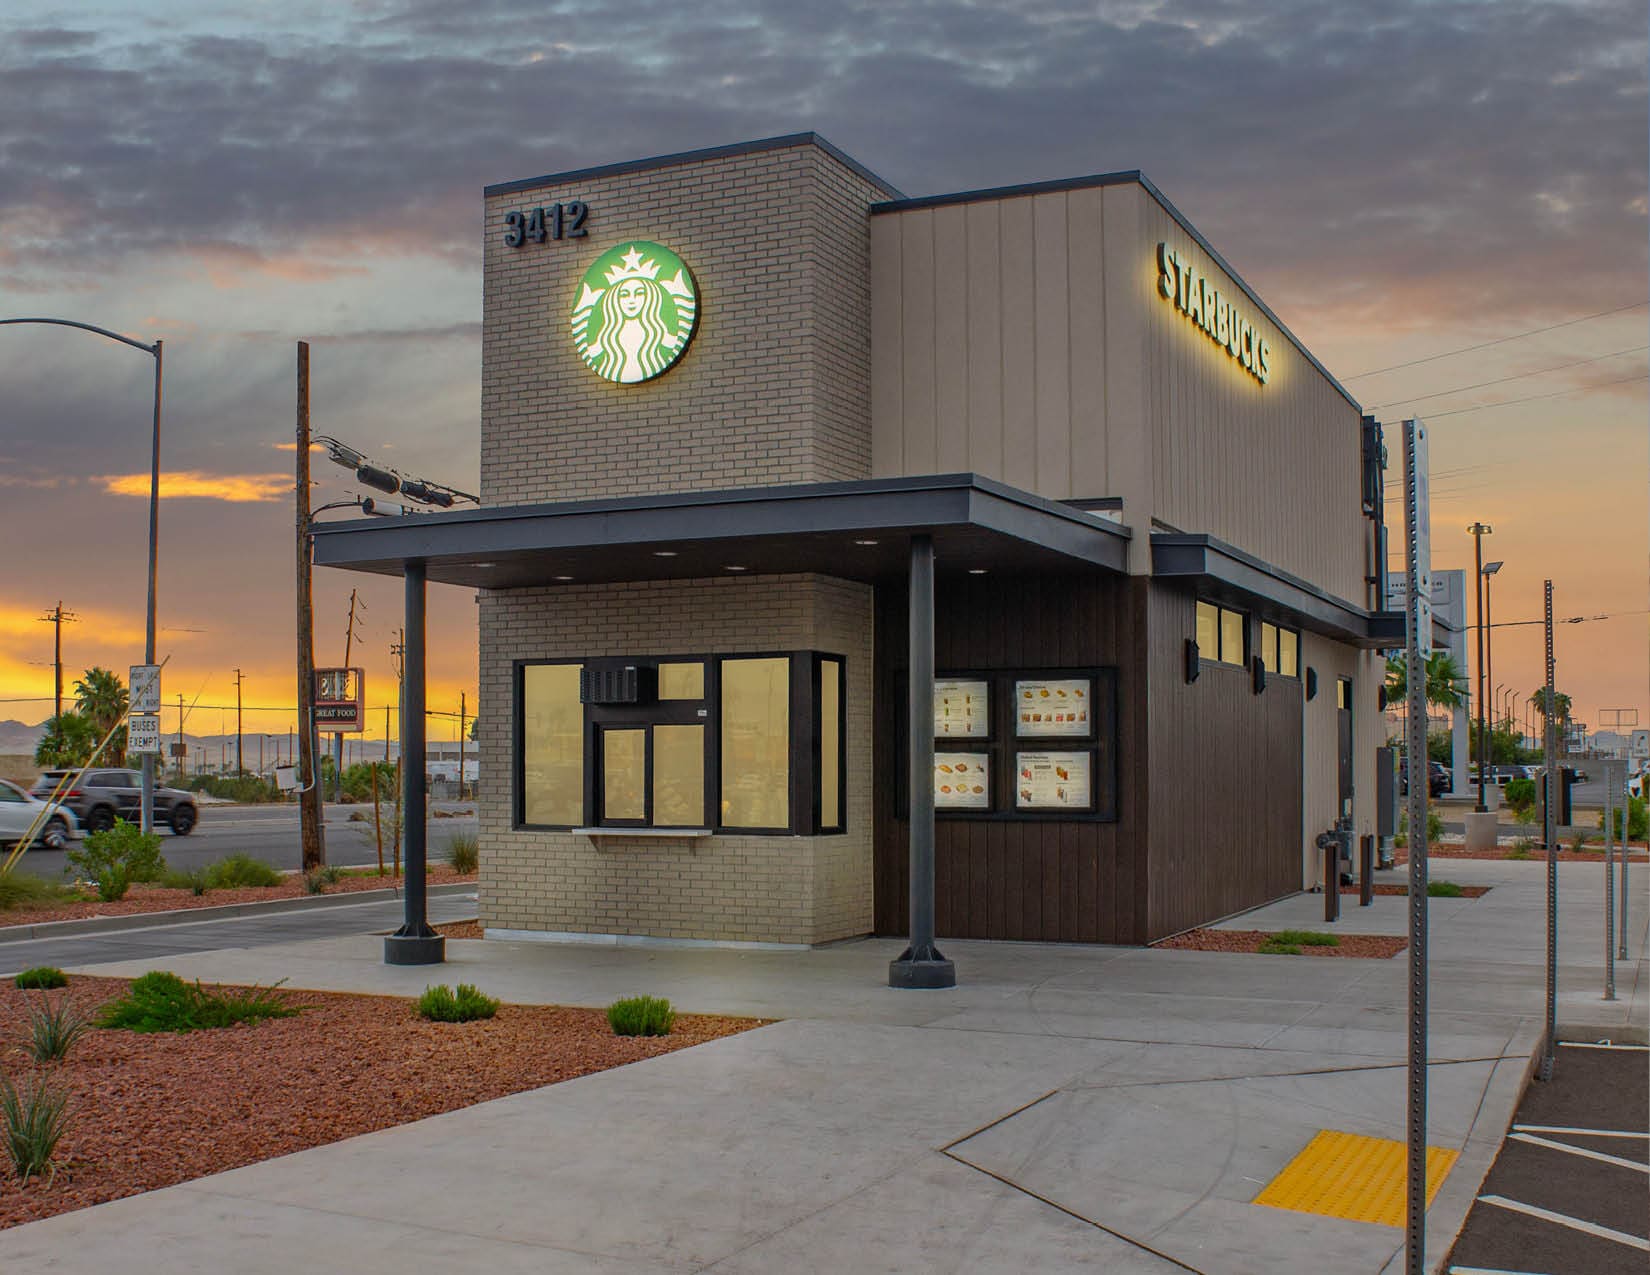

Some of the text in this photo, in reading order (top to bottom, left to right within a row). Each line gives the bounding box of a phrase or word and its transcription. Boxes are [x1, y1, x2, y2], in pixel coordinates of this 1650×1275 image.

[505, 199, 589, 248] 3412
[1157, 241, 1272, 385] STARBUCKS
[338, 709, 356, 717] FOOD
[131, 720, 156, 732] BUSES
[129, 736, 157, 748] EXEMPT
